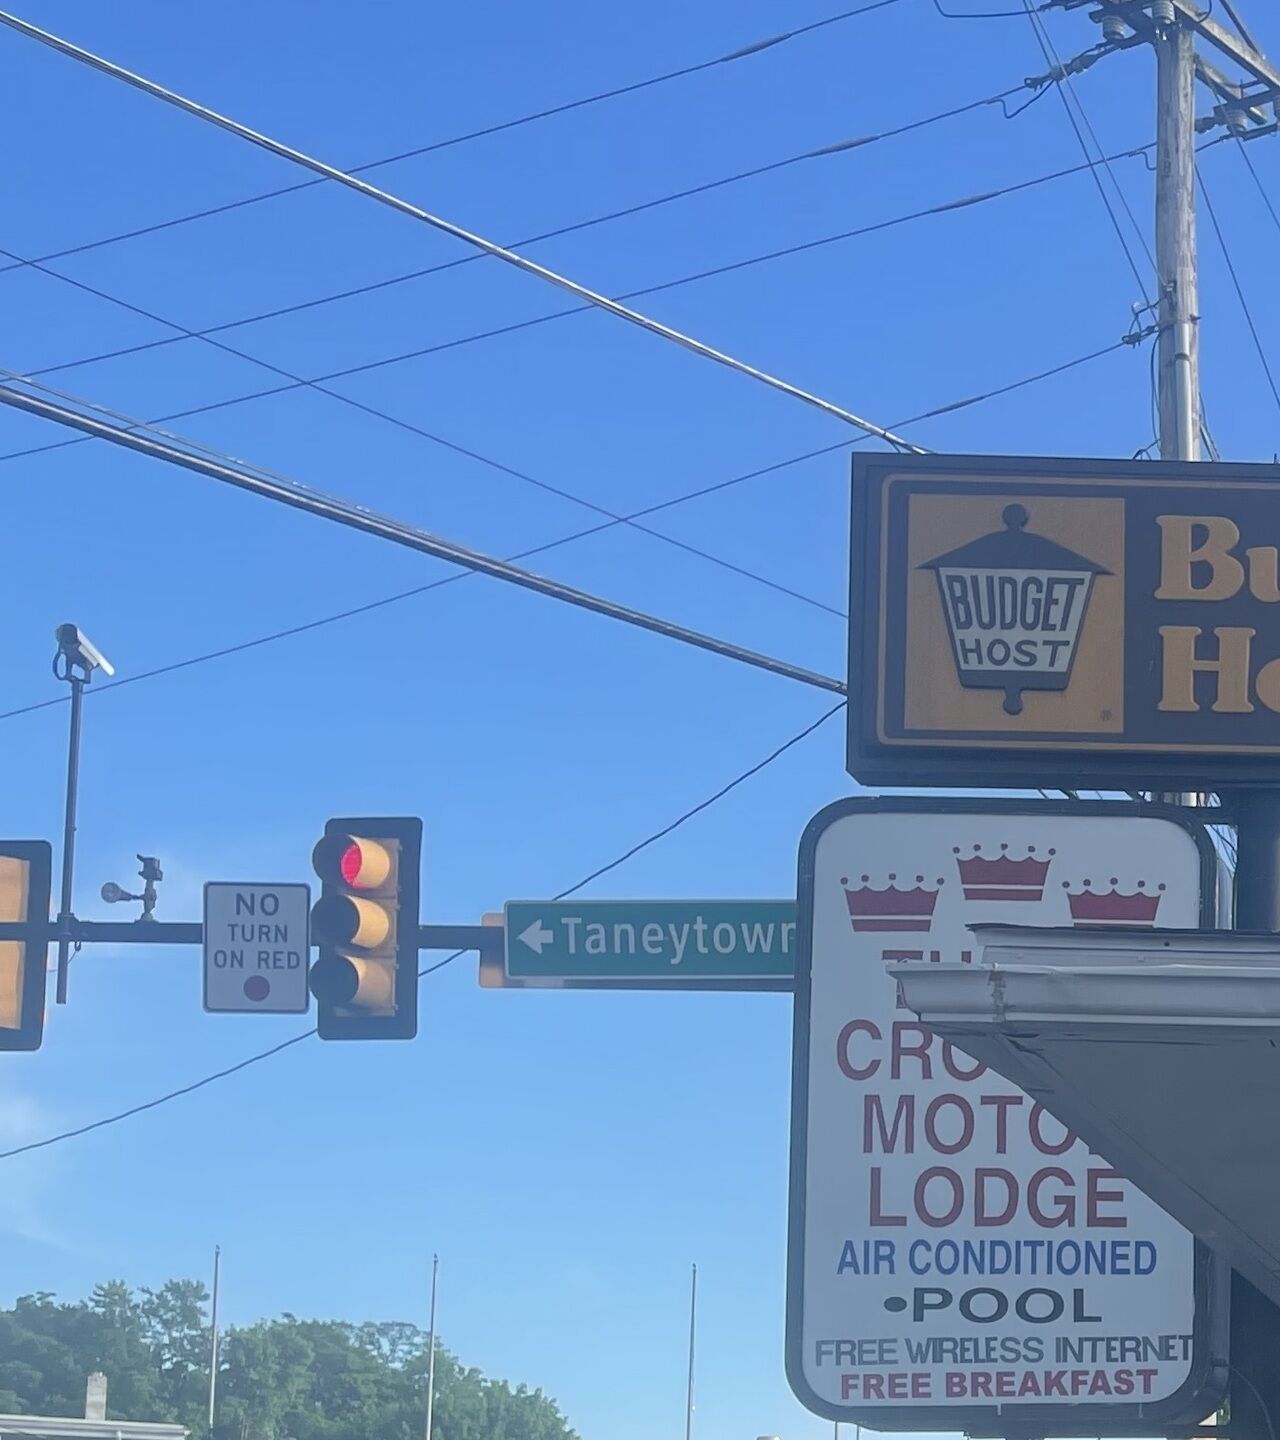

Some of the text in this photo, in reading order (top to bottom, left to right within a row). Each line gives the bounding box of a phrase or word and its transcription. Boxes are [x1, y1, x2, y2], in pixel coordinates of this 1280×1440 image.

[945, 574, 1085, 632] BUDGET
[958, 638, 1070, 667] HOST
[235, 893, 279, 916] NO
[227, 923, 288, 943] TURN
[213, 949, 300, 970] ON RED
[863, 1093, 1098, 1155] MOTO
[869, 1166, 1128, 1229] LODGE
[837, 1239, 1157, 1276] AIR CONDITIONED
[815, 1335, 1193, 1367] FREE WIRELESS INTERNET
[841, 1368, 1158, 1400] FREE BREAKFAST
